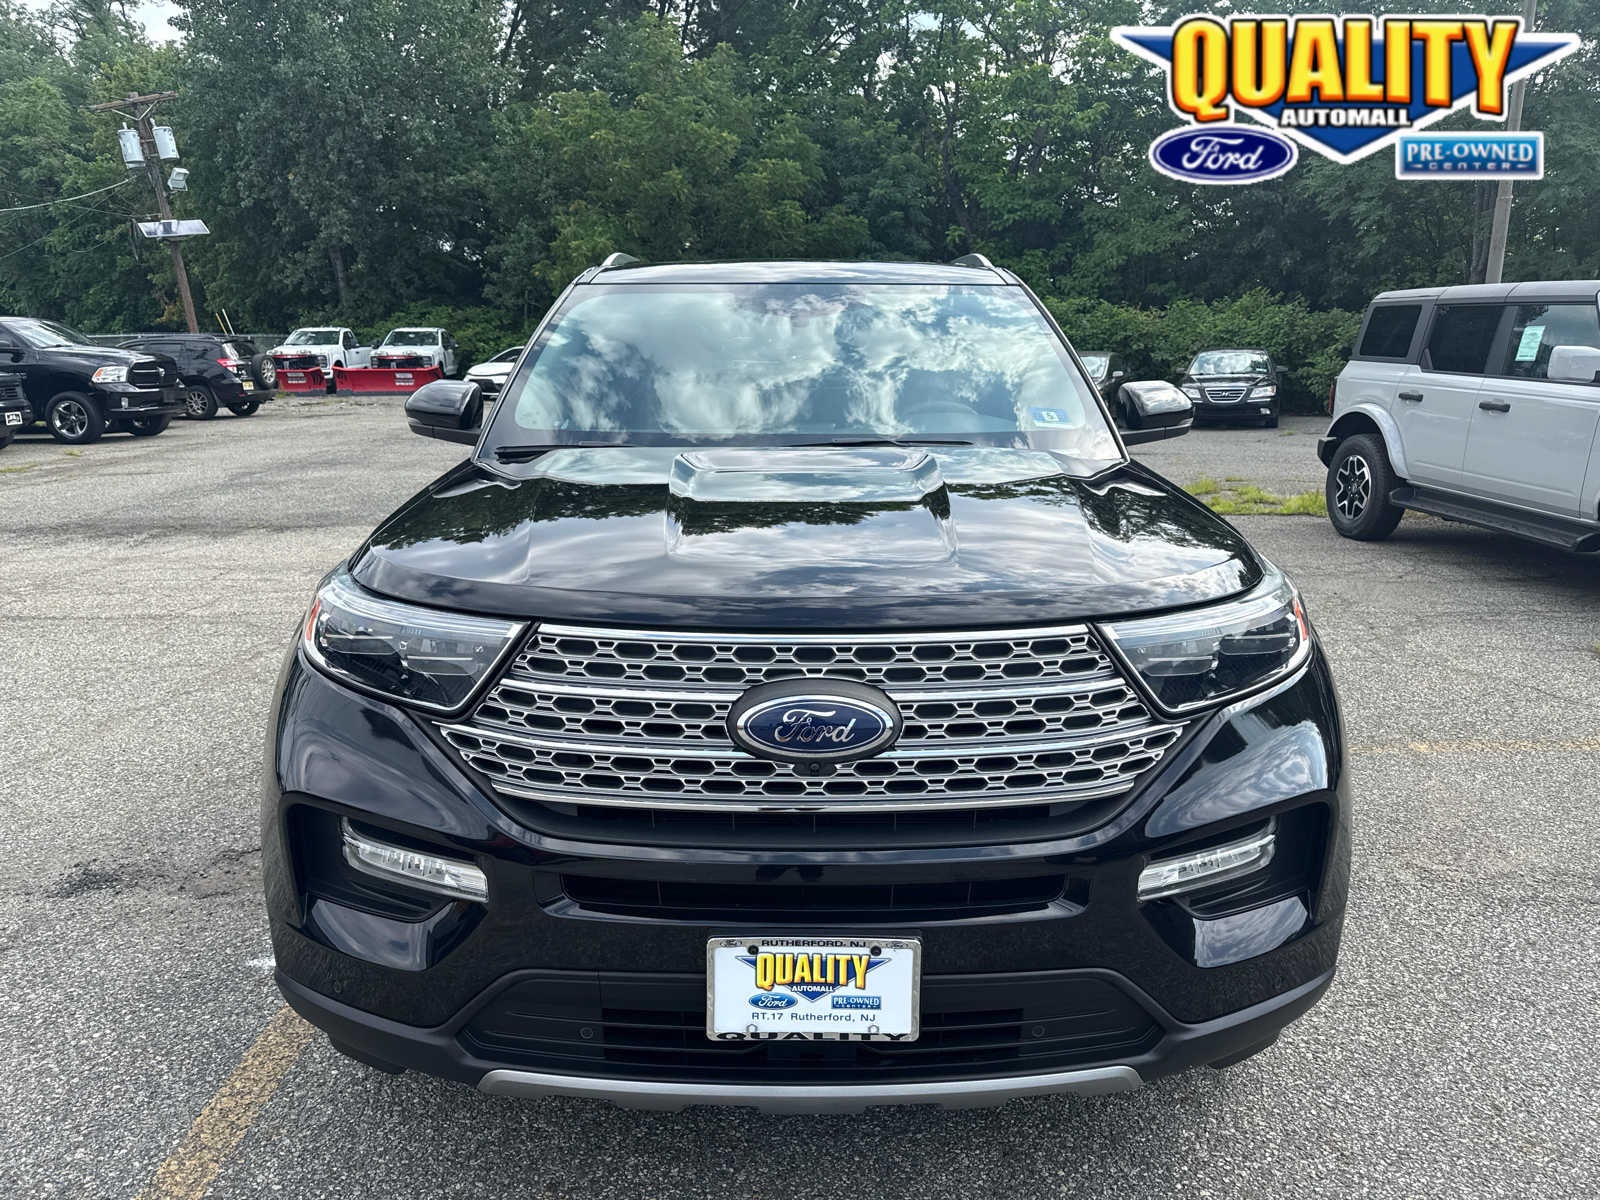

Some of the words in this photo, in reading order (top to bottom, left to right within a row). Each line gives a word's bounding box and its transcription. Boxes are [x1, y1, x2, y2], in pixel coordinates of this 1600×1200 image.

[774, 709, 856, 742] Ford
[755, 952, 871, 991] QUALITY
[758, 997, 789, 1009] Ford
[833, 997, 880, 1005] PRE-OWNED
[790, 1012, 856, 1022] Rutherford,
[860, 1013, 876, 1022] NJ
